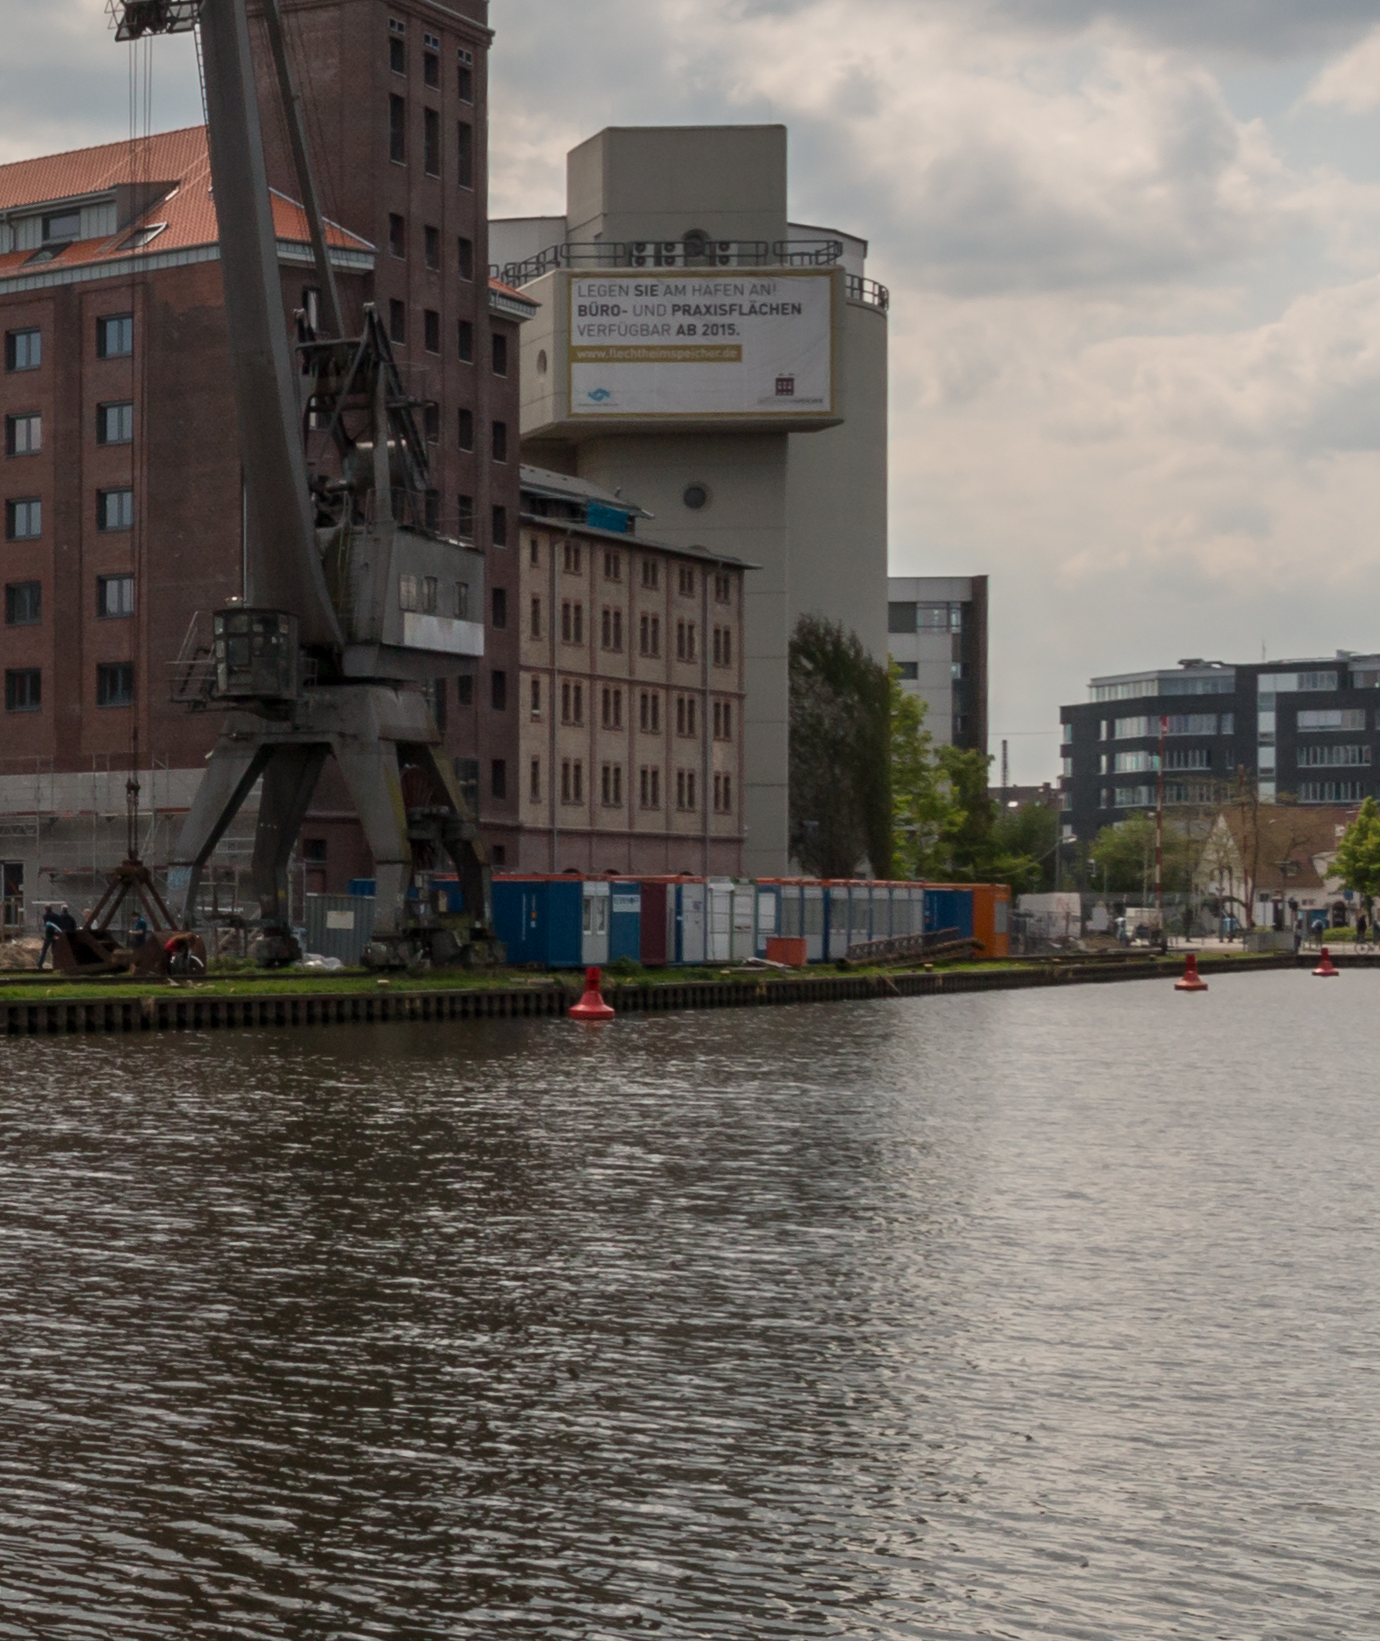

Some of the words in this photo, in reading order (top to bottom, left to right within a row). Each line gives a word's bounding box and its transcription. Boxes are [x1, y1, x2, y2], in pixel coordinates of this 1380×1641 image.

[577, 284, 629, 298] LEGEN
[634, 284, 659, 297] SIE
[663, 284, 686, 297] AM
[692, 284, 744, 297] HAFEN
[749, 283, 776, 296] AN!
[577, 301, 628, 317] BÜRO-
[632, 304, 667, 317] UND
[671, 300, 802, 317] PRAXISFLÄCHEN
[577, 321, 671, 337] VERFÜGBAR
[676, 323, 697, 337] AB
[702, 323, 741, 337] 2015.
